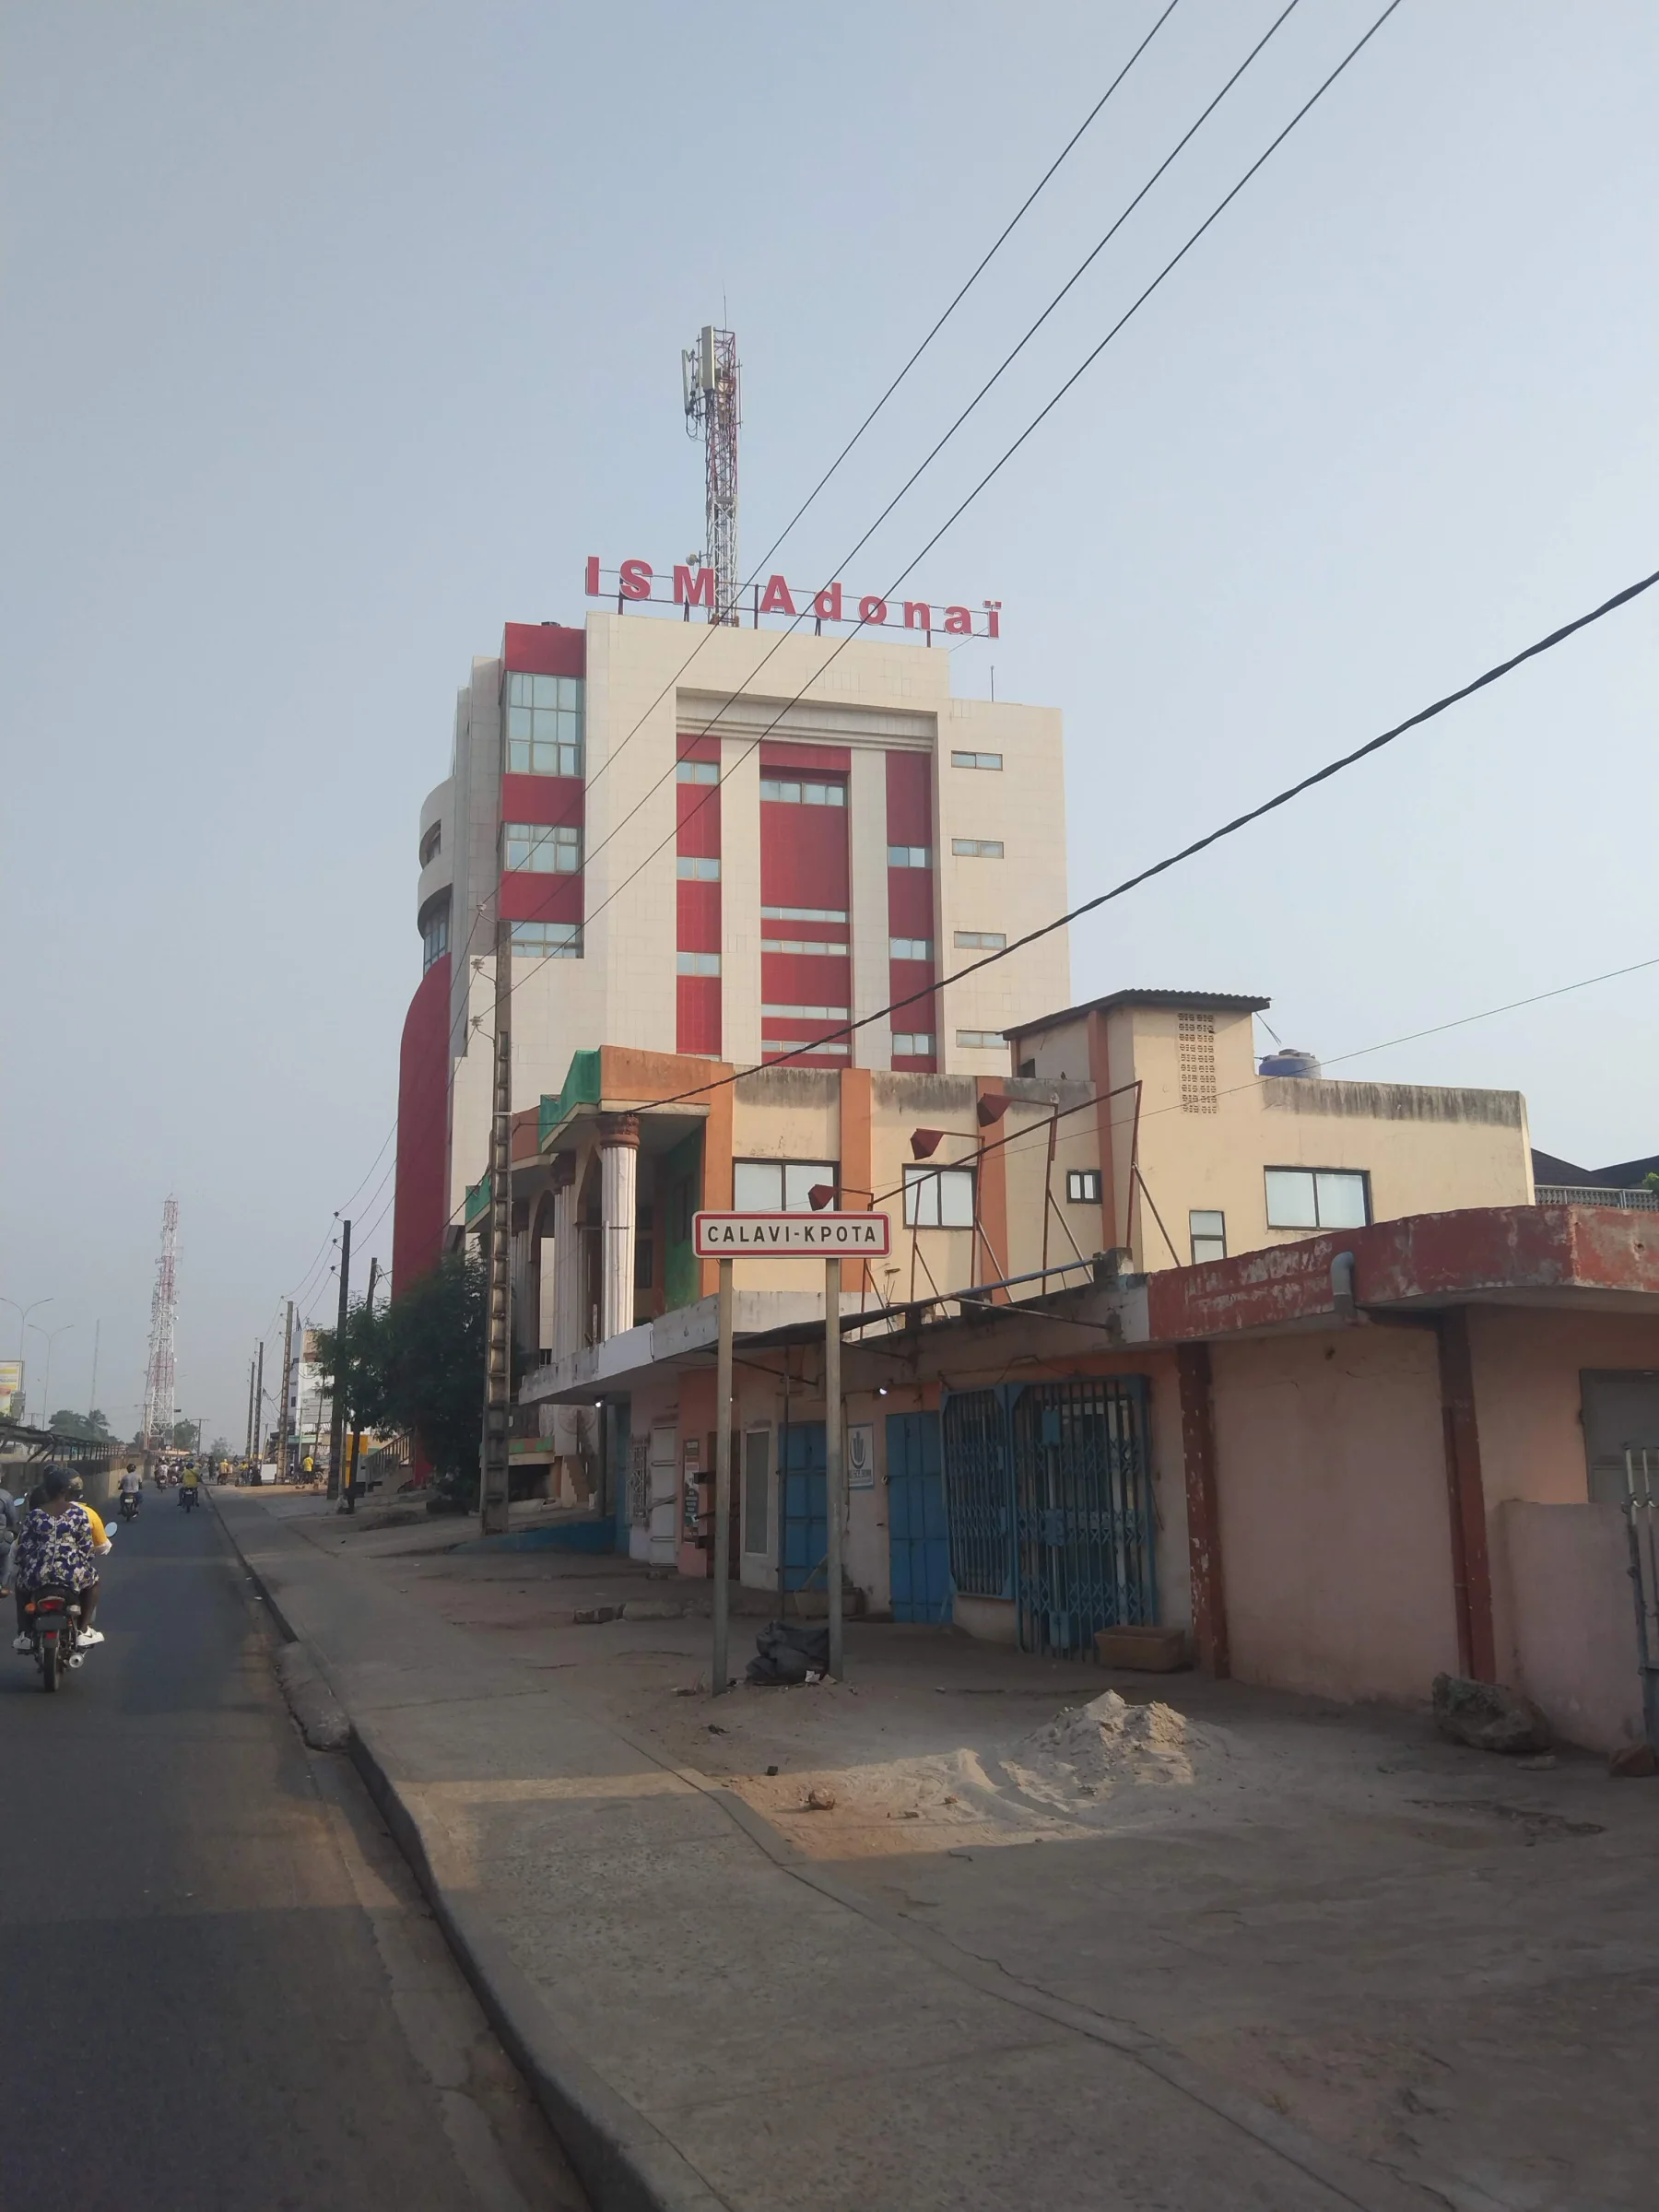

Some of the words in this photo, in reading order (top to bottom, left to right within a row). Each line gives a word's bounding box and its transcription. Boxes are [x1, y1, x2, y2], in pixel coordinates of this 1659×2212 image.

[585, 555, 716, 608] ISM
[759, 573, 1003, 639] Adonaï
[707, 1225, 877, 1242] CALAVI-KPOTA
